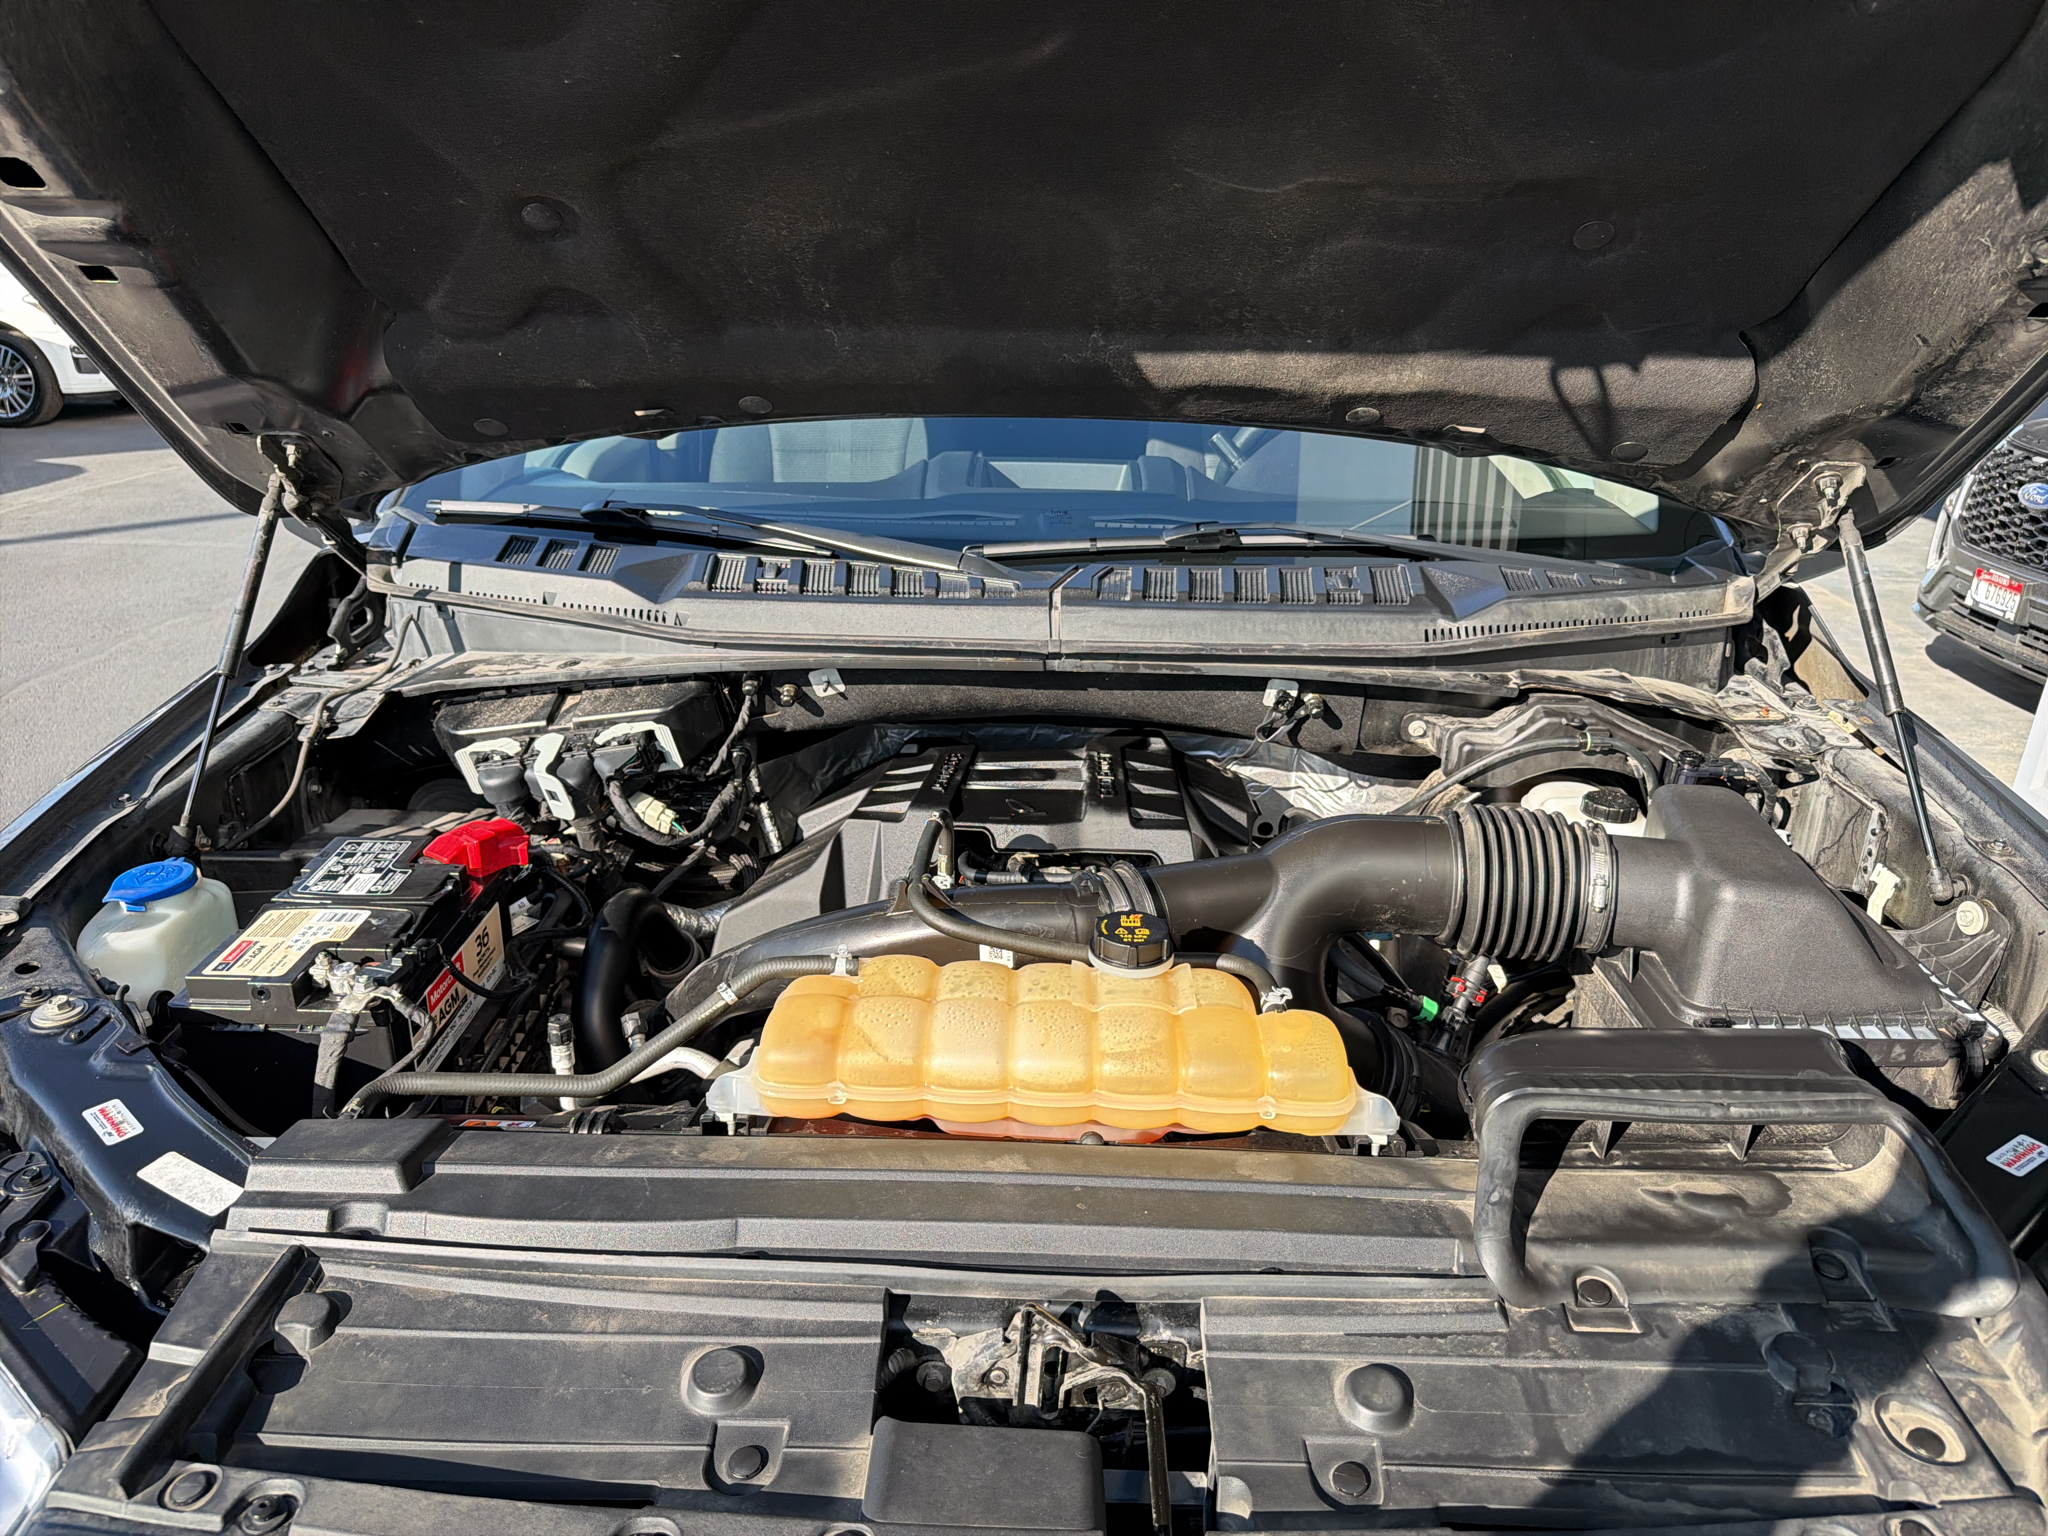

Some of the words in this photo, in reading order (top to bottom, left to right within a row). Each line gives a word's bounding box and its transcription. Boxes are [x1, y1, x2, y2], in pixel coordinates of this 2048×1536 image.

[1985, 582, 2018, 611] 676925
[475, 926, 490, 957] 36
[439, 987, 460, 1026] AGM
[97, 1106, 127, 1138] WARNING
[2004, 1142, 2043, 1168] WARNING
